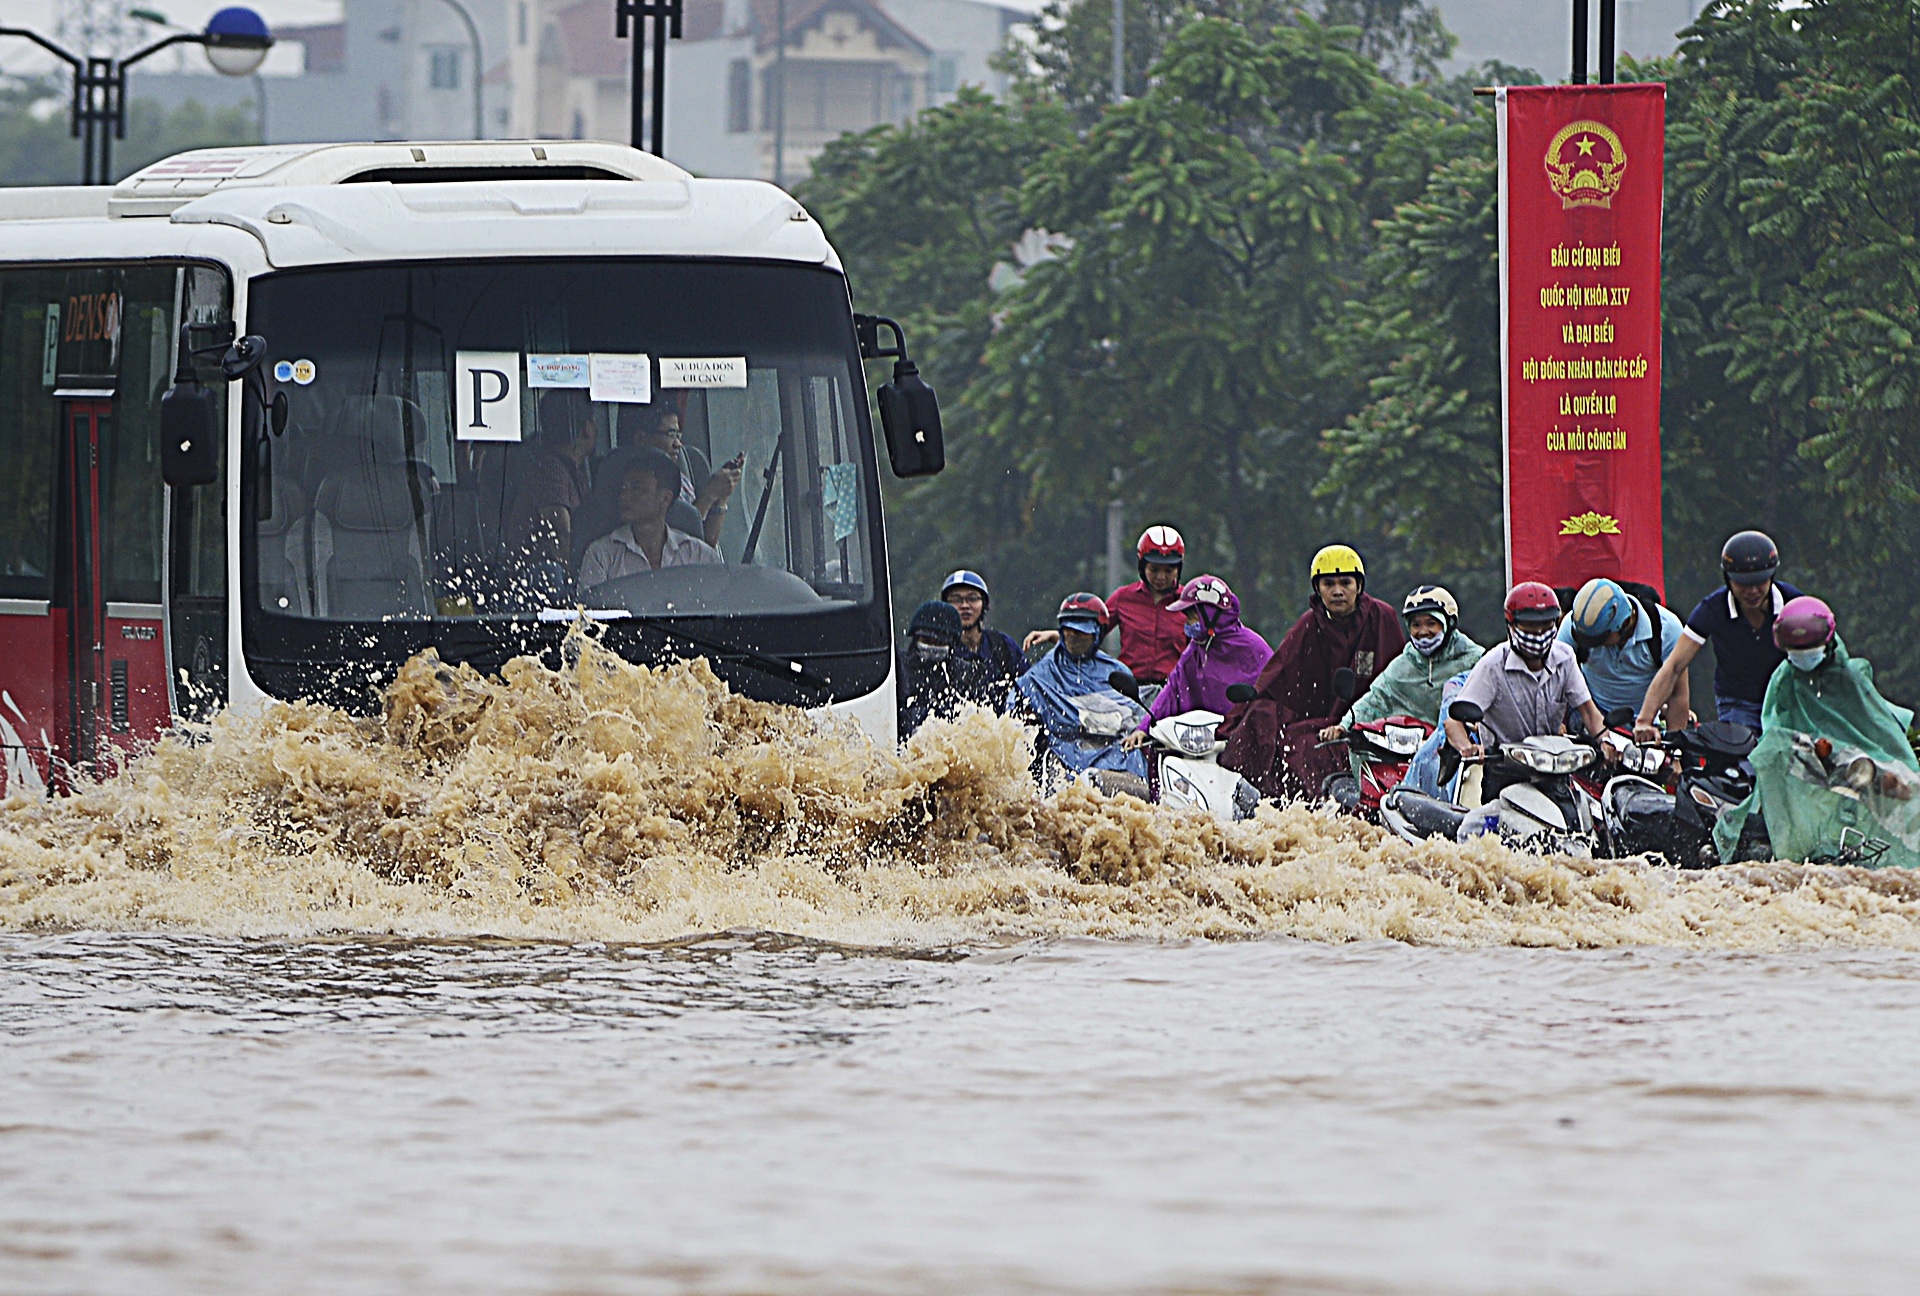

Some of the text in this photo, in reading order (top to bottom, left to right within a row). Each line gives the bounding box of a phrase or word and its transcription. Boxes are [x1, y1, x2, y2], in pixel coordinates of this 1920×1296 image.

[1551, 240, 1621, 270] BẦU CỬ ĐẠI BIỂU
[1540, 281, 1630, 310] QUỐC HỘI KHÓA XIV
[65, 292, 118, 342] DENSO
[1562, 316, 1615, 347] VÀ ĐẠI BIỂU
[1522, 353, 1648, 384] HỘI ĐỒNG NHÂN DÂN CÁC CẤP
[468, 368, 510, 429] P
[1559, 392, 1571, 415] LÀ
[1573, 389, 1603, 417] QUYỀN
[1546, 424, 1566, 451] CỦA
[1568, 425, 1585, 450] MỖI
[1587, 427, 1612, 450] CÔNG
